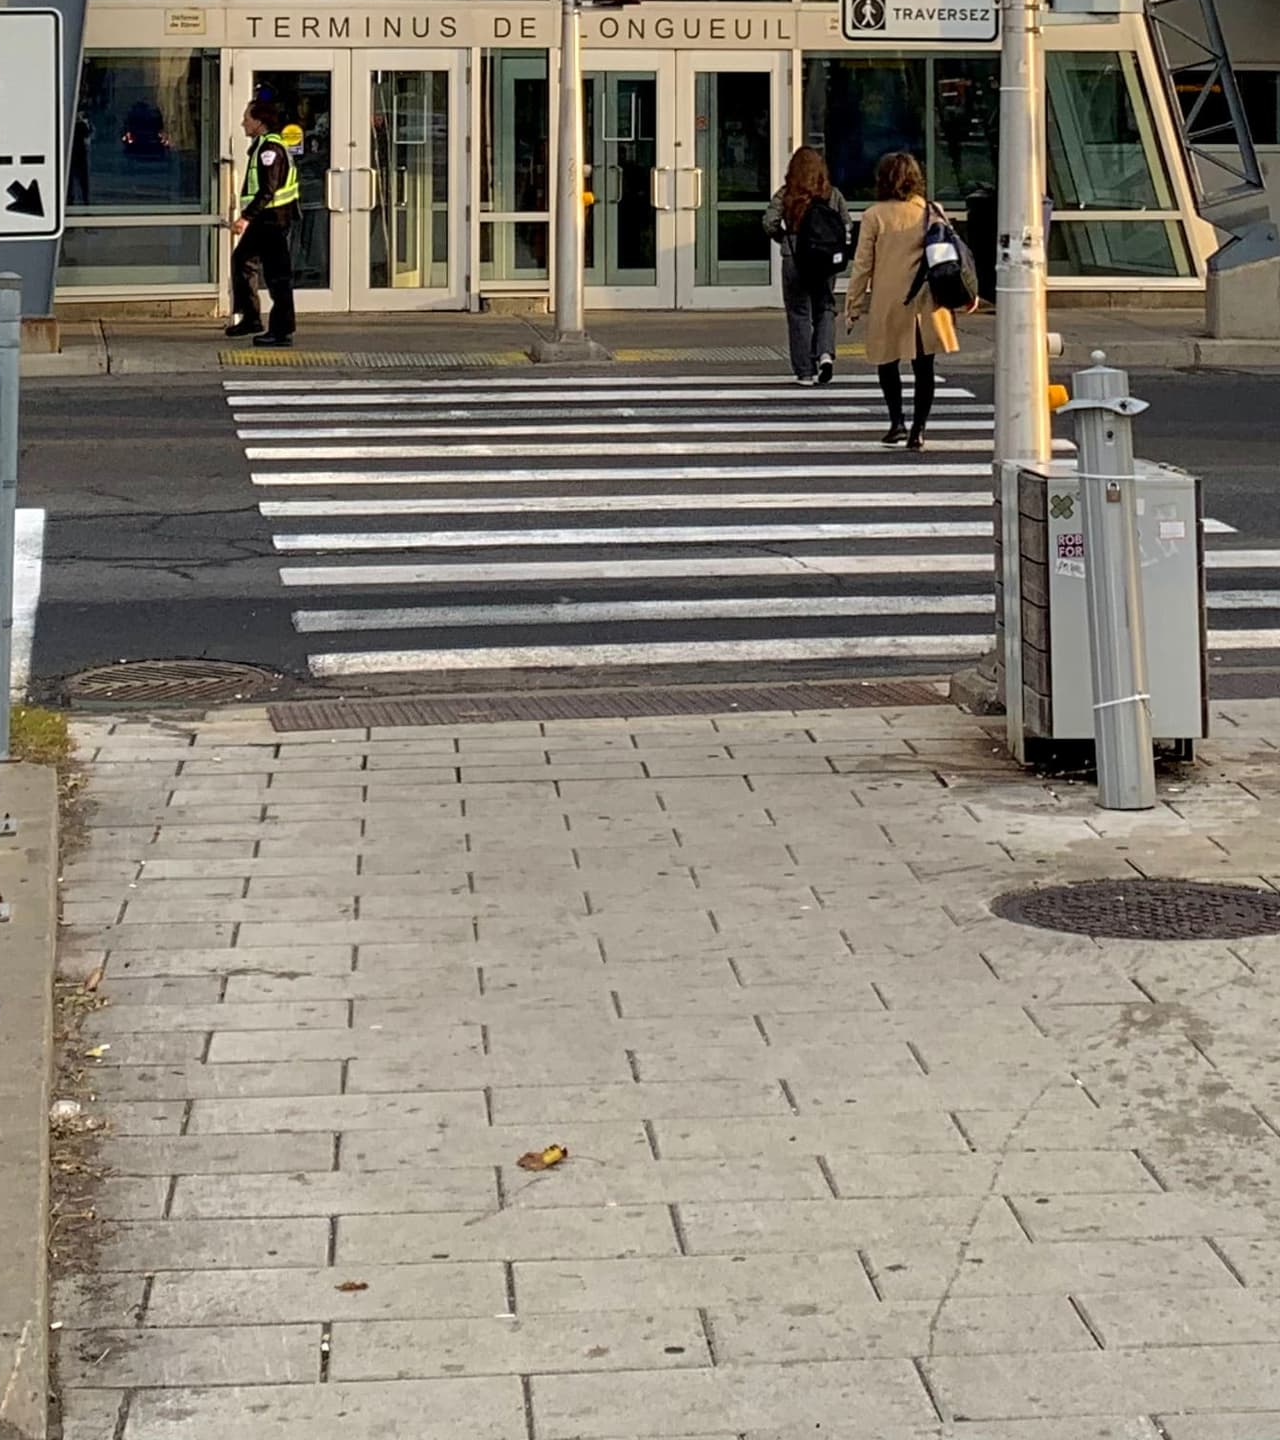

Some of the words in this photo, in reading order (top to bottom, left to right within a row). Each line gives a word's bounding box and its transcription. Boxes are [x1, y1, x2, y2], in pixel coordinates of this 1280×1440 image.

[893, 8, 990, 21] TRAVERSEZ
[246, 16, 457, 38] TERMINUS
[494, 17, 537, 38] DE
[580, 17, 791, 39] ONGUEUIL
[1058, 535, 1083, 545] ROB
[1058, 546, 1083, 557] FOR
